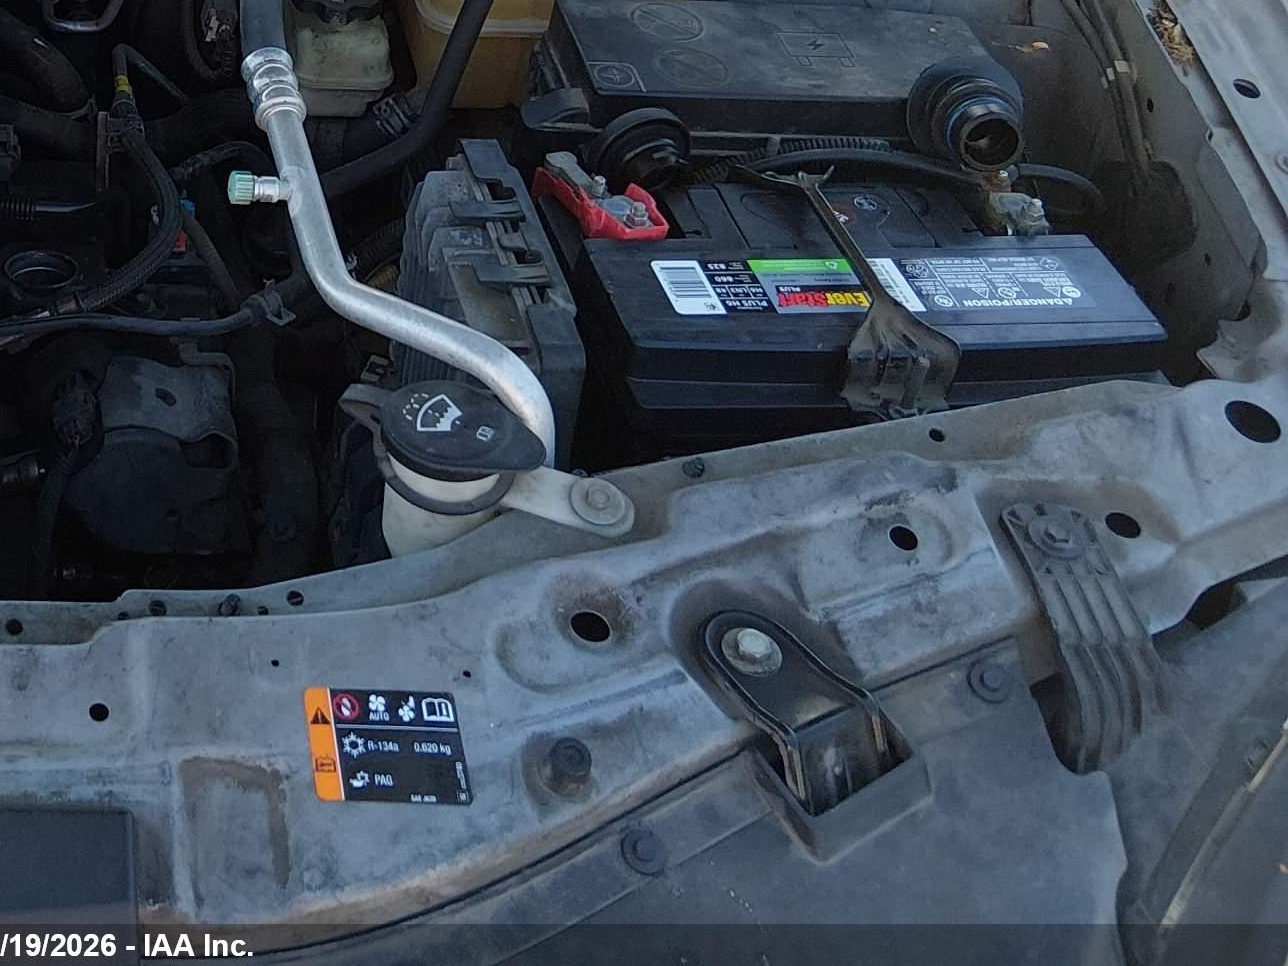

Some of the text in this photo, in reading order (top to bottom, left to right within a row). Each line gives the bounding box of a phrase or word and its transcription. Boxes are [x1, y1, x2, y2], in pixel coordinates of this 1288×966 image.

[741, 299, 769, 307] PLUS
[776, 291, 871, 307] EverStart
[369, 711, 390, 722] AUTO
[367, 740, 400, 752] R-134a
[439, 742, 452, 756] kg
